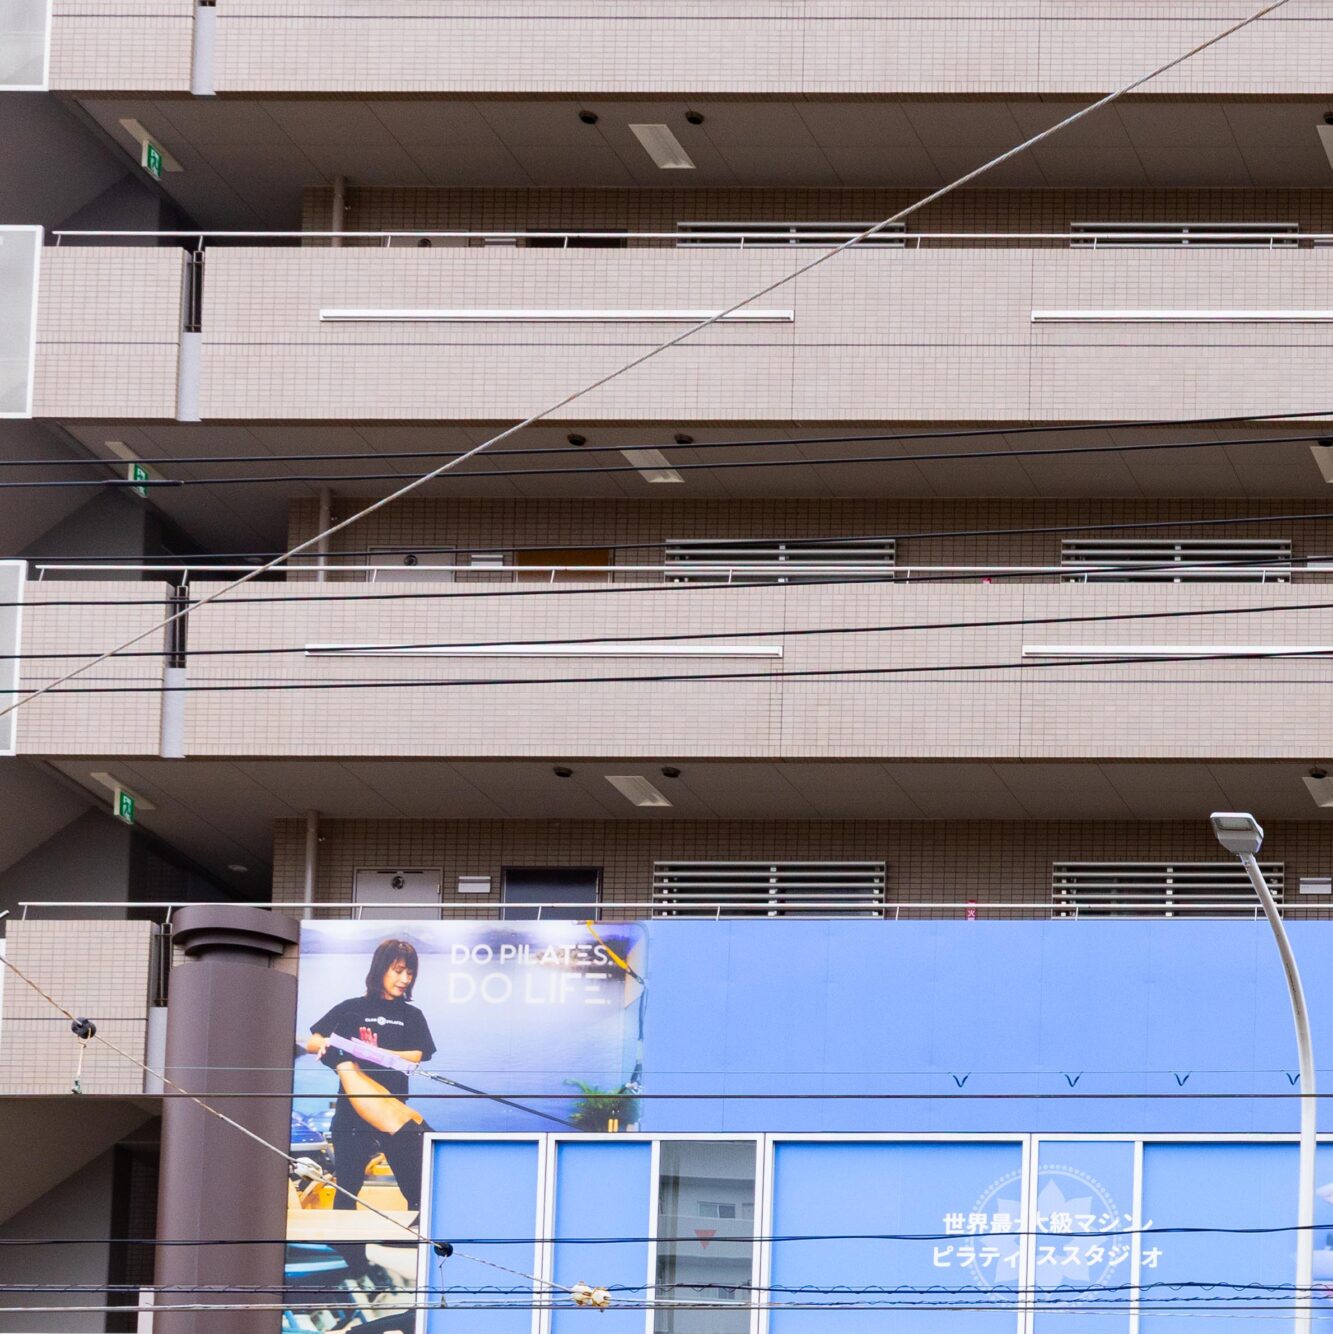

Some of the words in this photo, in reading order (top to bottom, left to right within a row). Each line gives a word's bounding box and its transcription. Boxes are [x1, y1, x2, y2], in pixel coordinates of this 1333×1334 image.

[450, 943, 493, 965] DO
[449, 972, 512, 1005] DO
[933, 1246, 1163, 1268] ピラティススタジオ
